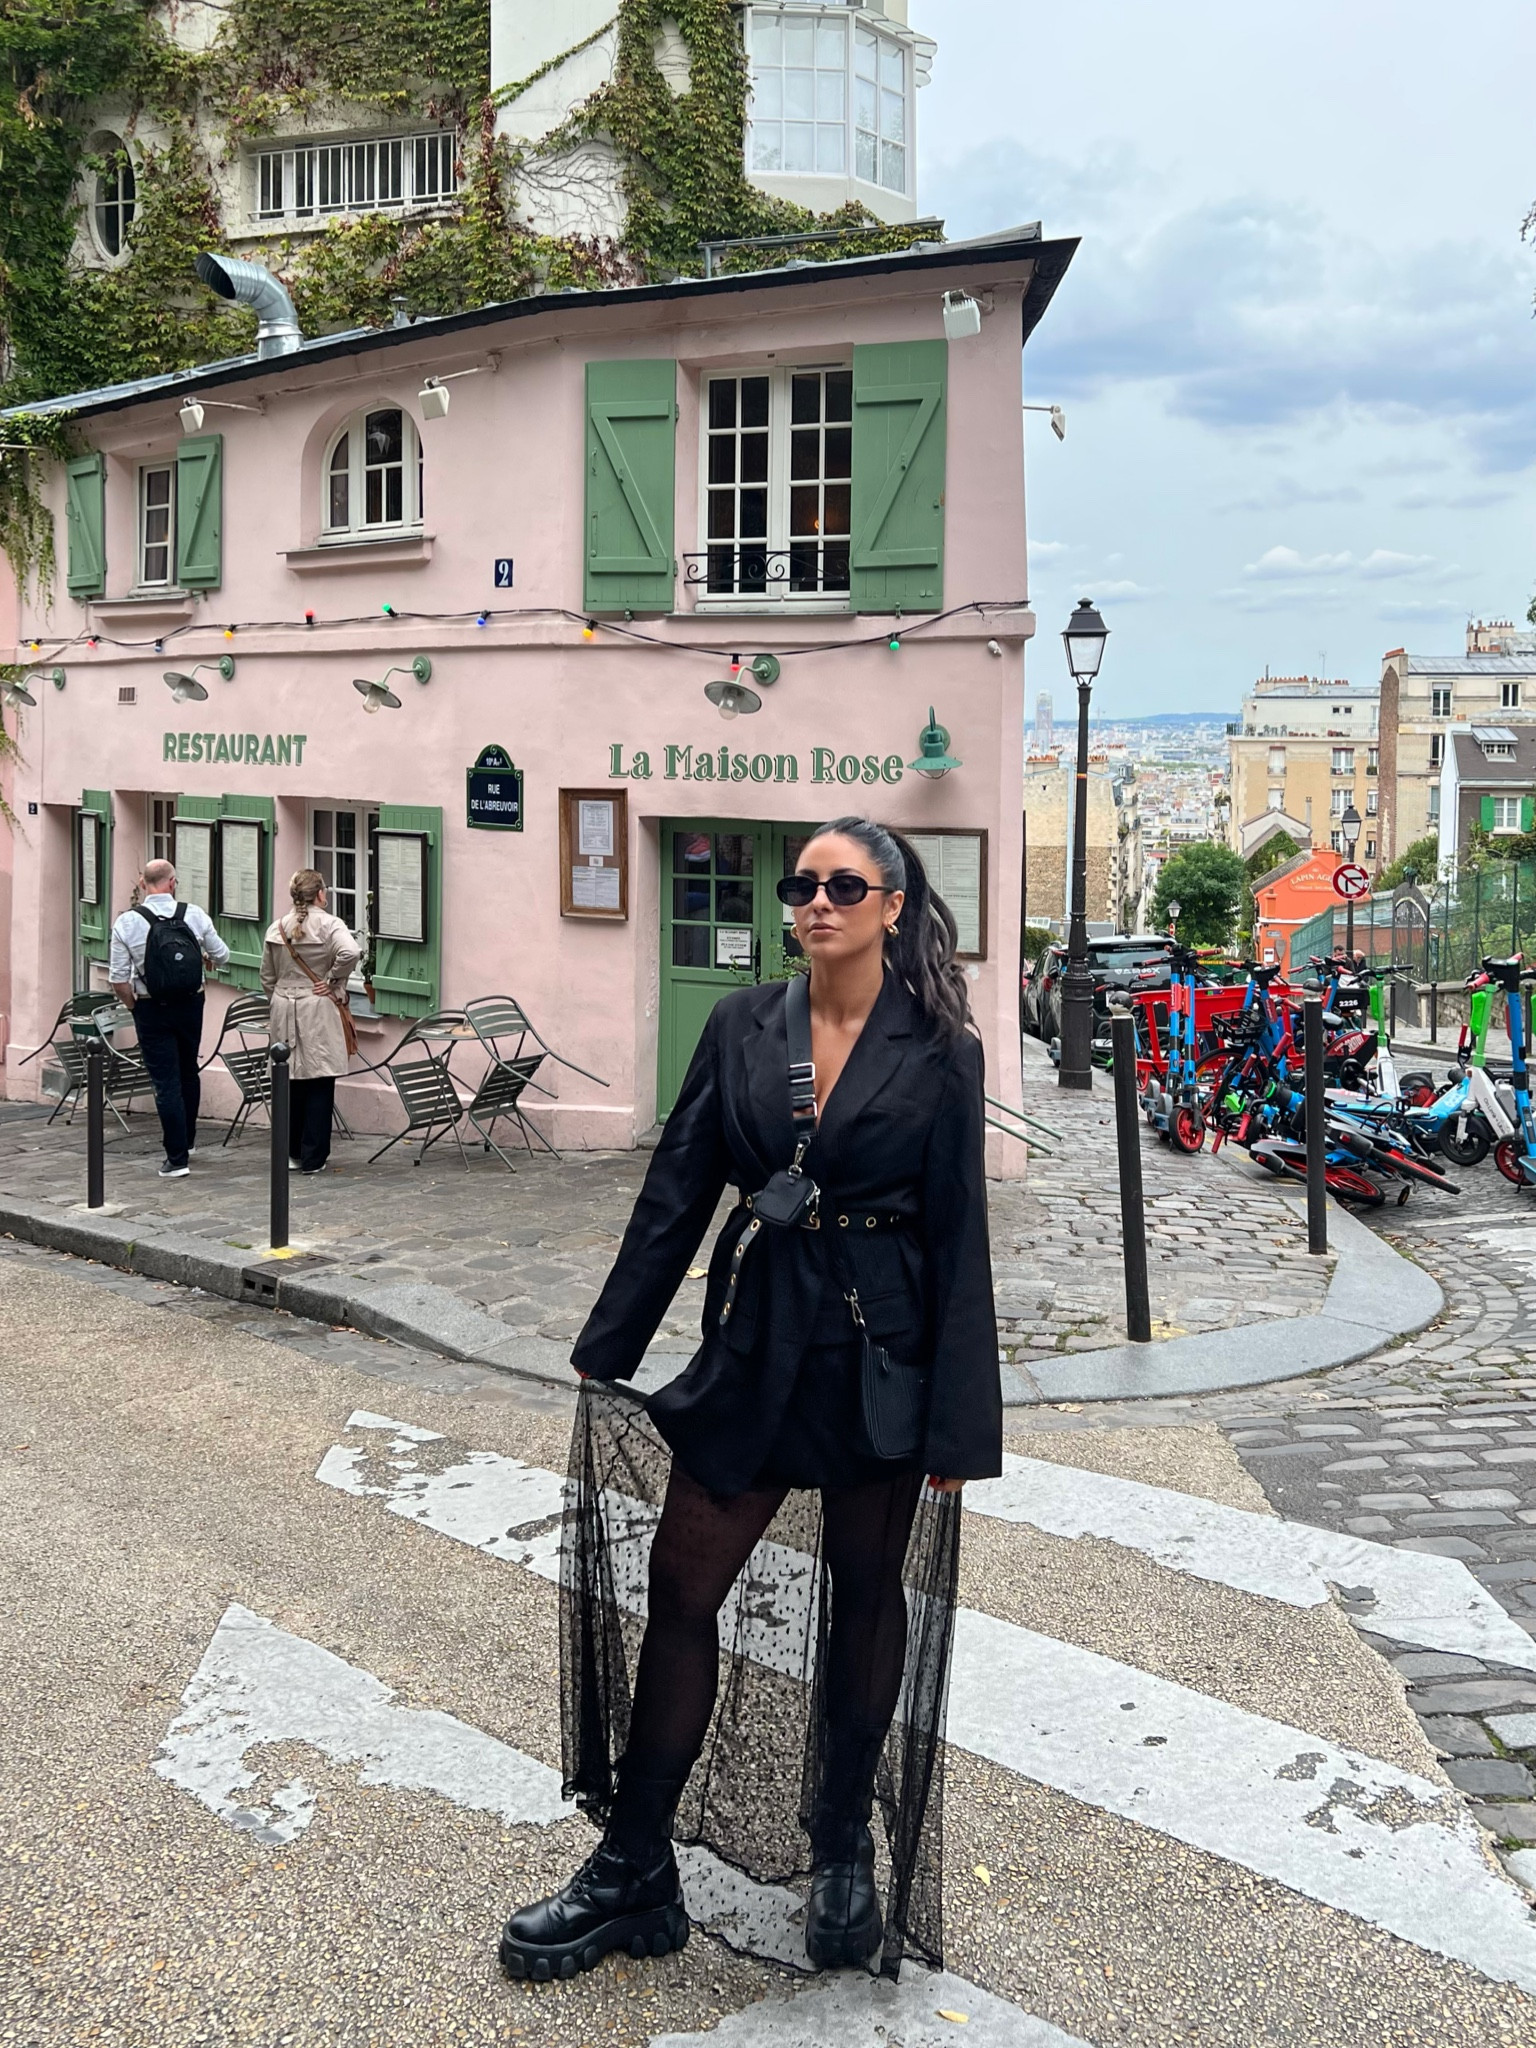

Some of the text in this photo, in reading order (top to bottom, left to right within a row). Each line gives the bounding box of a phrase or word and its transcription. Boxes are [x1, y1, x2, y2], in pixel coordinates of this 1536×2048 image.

[498, 560, 509, 587] 2
[163, 732, 307, 767] RESTAURANT
[609, 743, 904, 784] La Maison Rose
[487, 784, 500, 794] RUE
[471, 799, 519, 812] DE L'ABREUVOIR
[1290, 872, 1315, 885] LAPIN
[1339, 999, 1359, 1007] 2226
